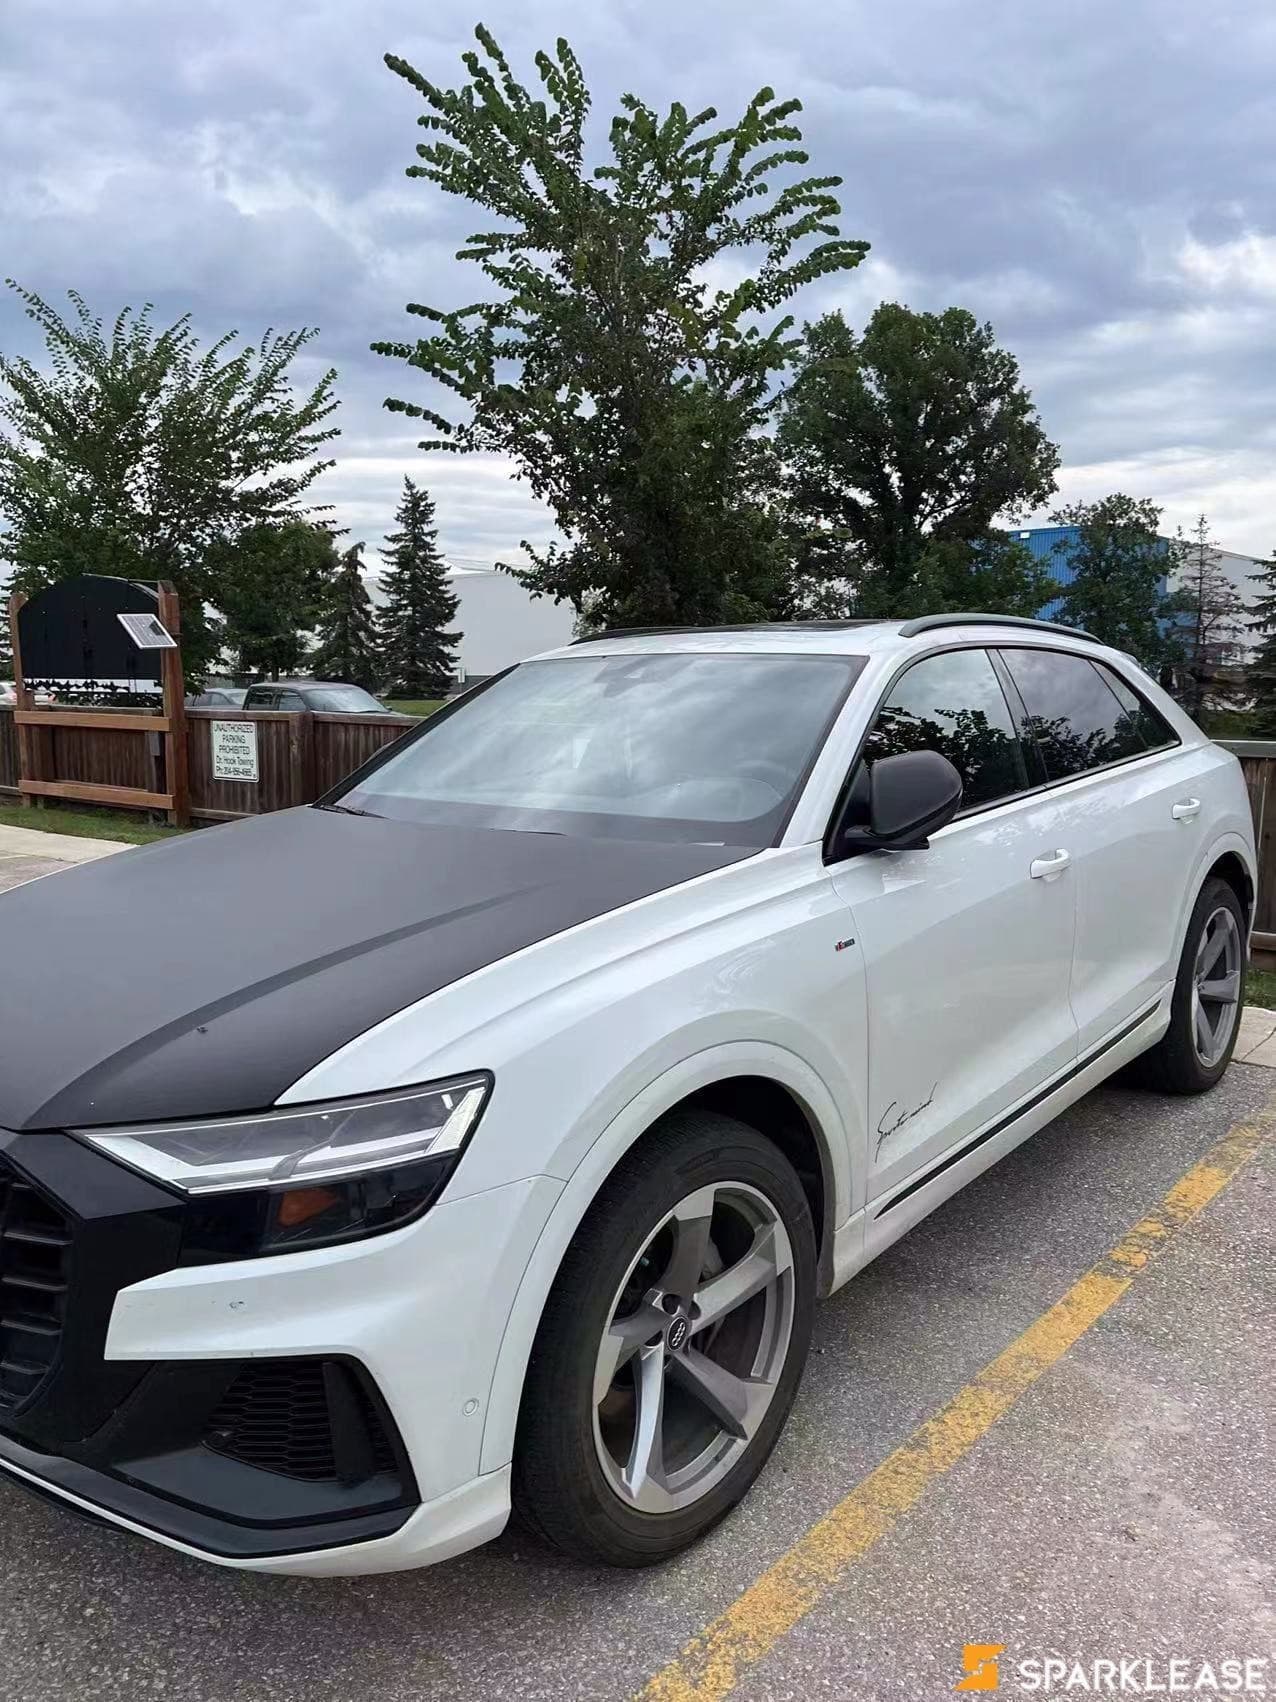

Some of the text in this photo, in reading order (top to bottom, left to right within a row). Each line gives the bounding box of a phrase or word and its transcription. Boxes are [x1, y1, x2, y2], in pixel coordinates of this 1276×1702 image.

[213, 723, 254, 733] UNAUTHORIZED
[222, 734, 246, 744] PARKING
[218, 744, 250, 755] PROHIBITED
